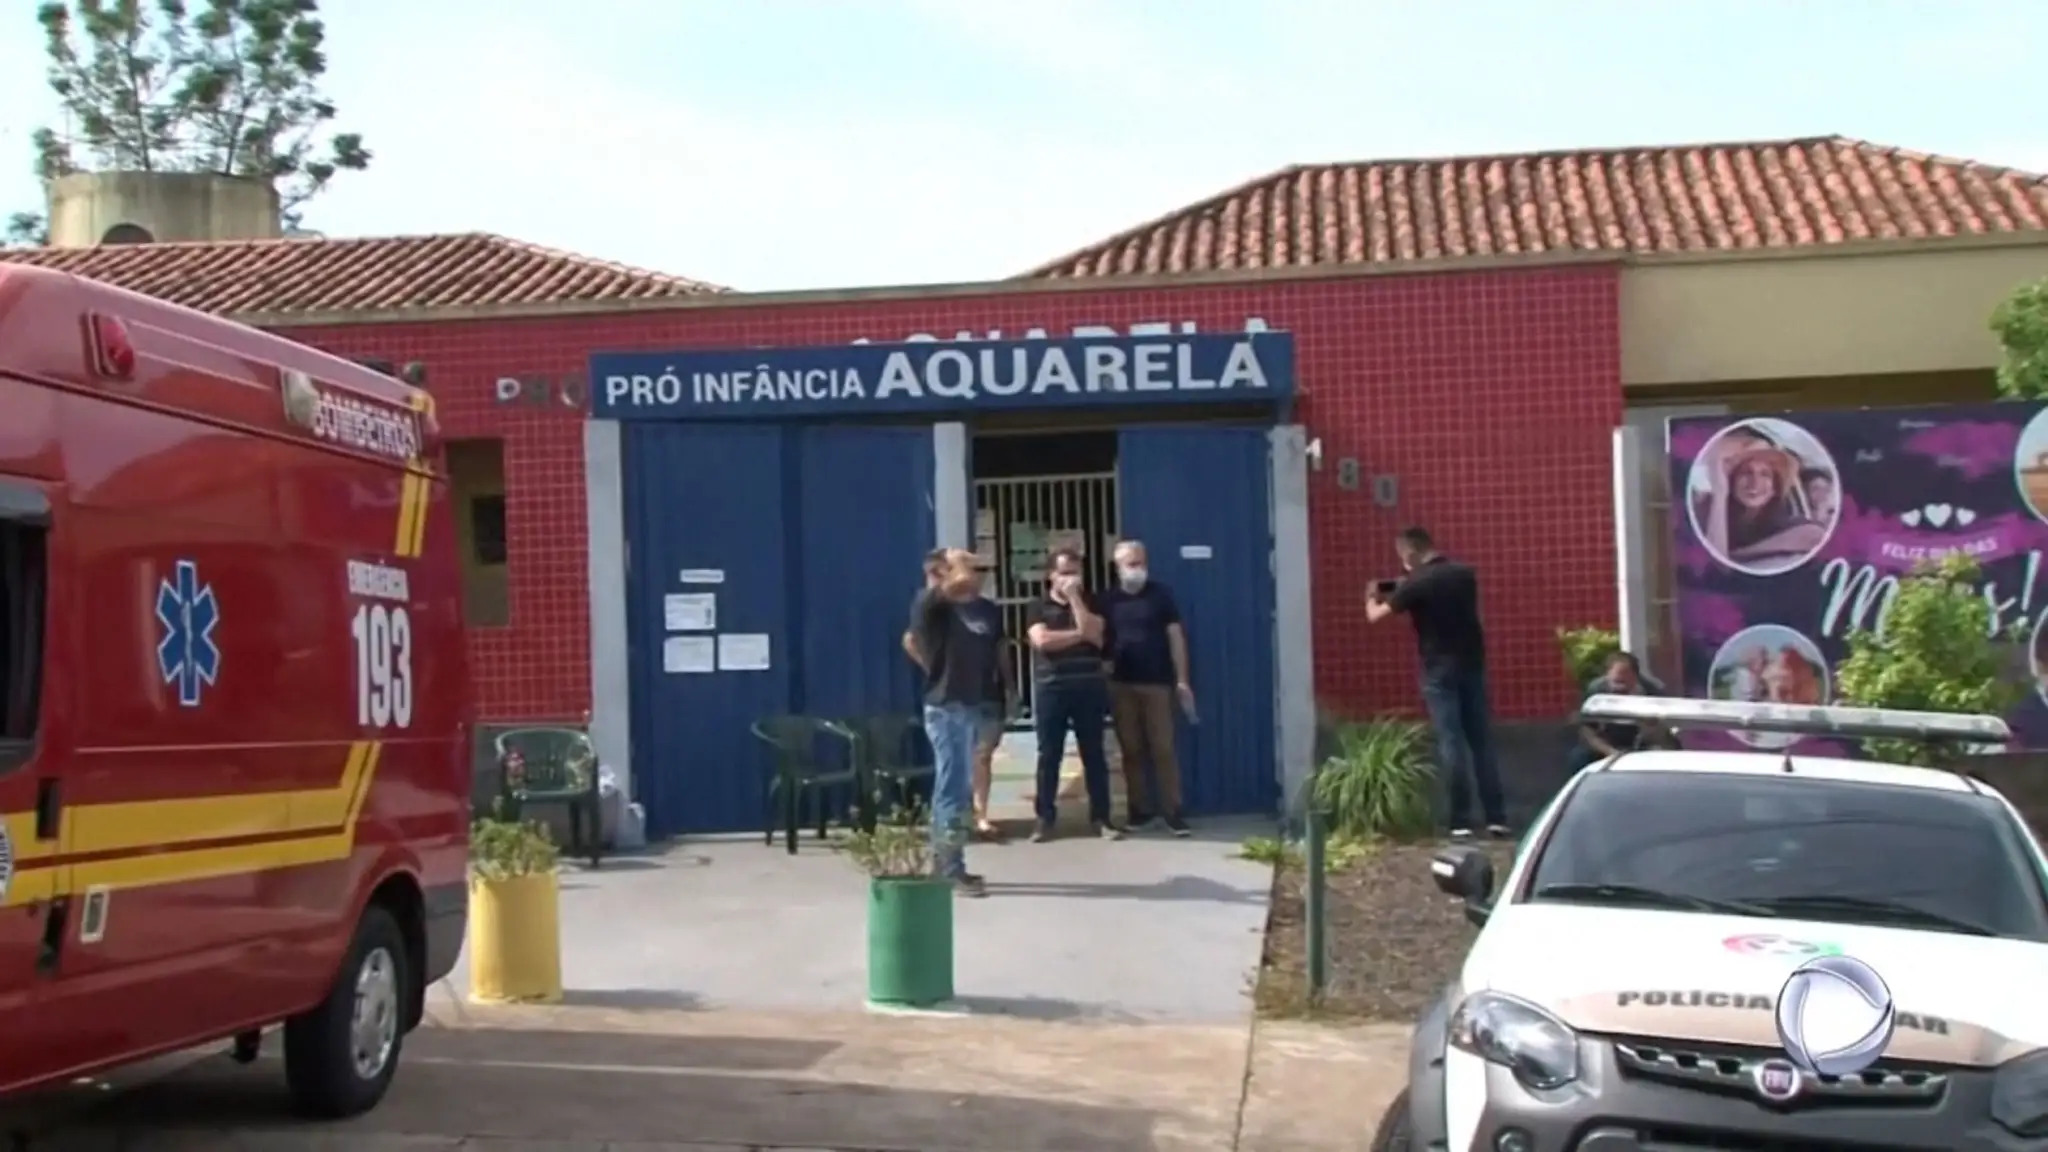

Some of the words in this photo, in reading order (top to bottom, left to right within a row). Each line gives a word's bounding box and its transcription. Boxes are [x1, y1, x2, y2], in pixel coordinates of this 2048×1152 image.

[606, 366, 681, 406] PRÓ
[692, 364, 865, 403] INFÂNCIA
[874, 342, 1269, 400] AQUARELA
[351, 603, 412, 729] 193
[1616, 988, 1774, 1012] POLÍCIA
